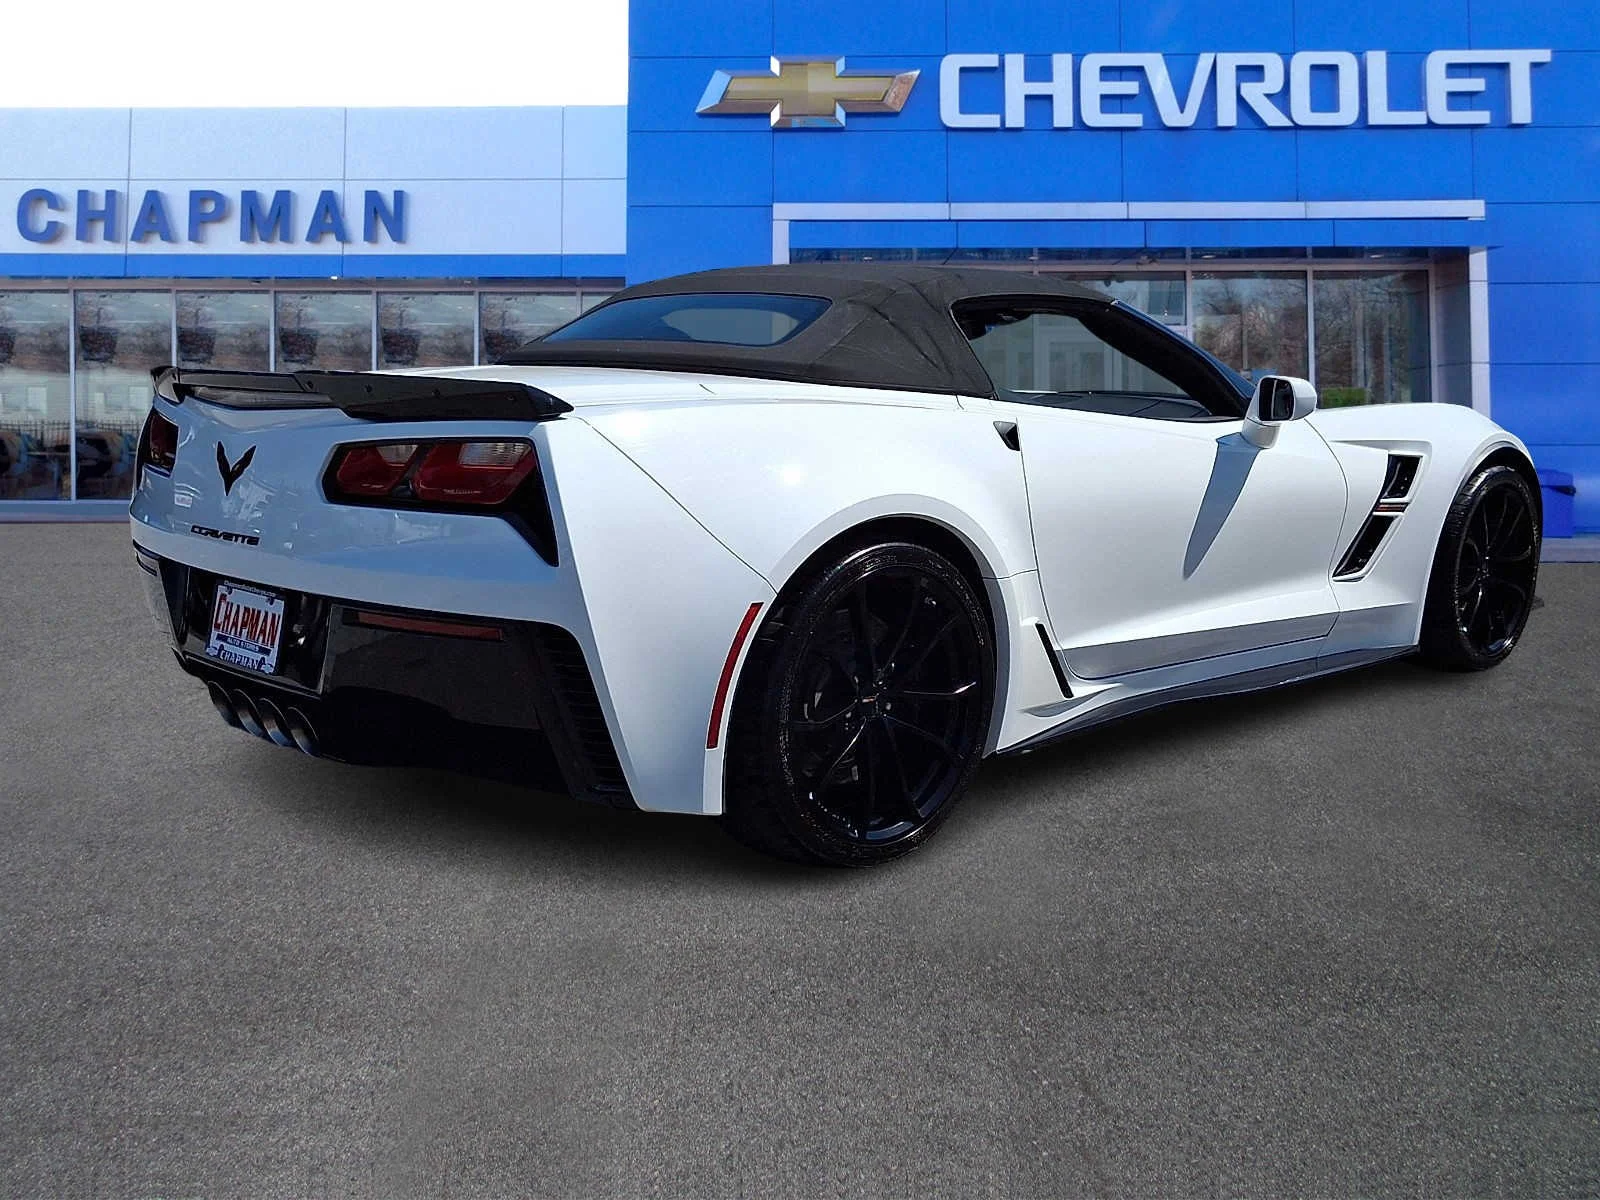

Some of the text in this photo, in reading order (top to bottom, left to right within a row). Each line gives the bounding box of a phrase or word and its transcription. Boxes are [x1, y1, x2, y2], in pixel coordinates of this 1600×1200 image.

[939, 48, 1552, 129] CHEVROLET
[16, 188, 409, 243] CHAPMAN
[191, 524, 260, 546] CORVETTE
[213, 593, 281, 648] CHAPMAN
[220, 649, 260, 670] CHAPMAN
